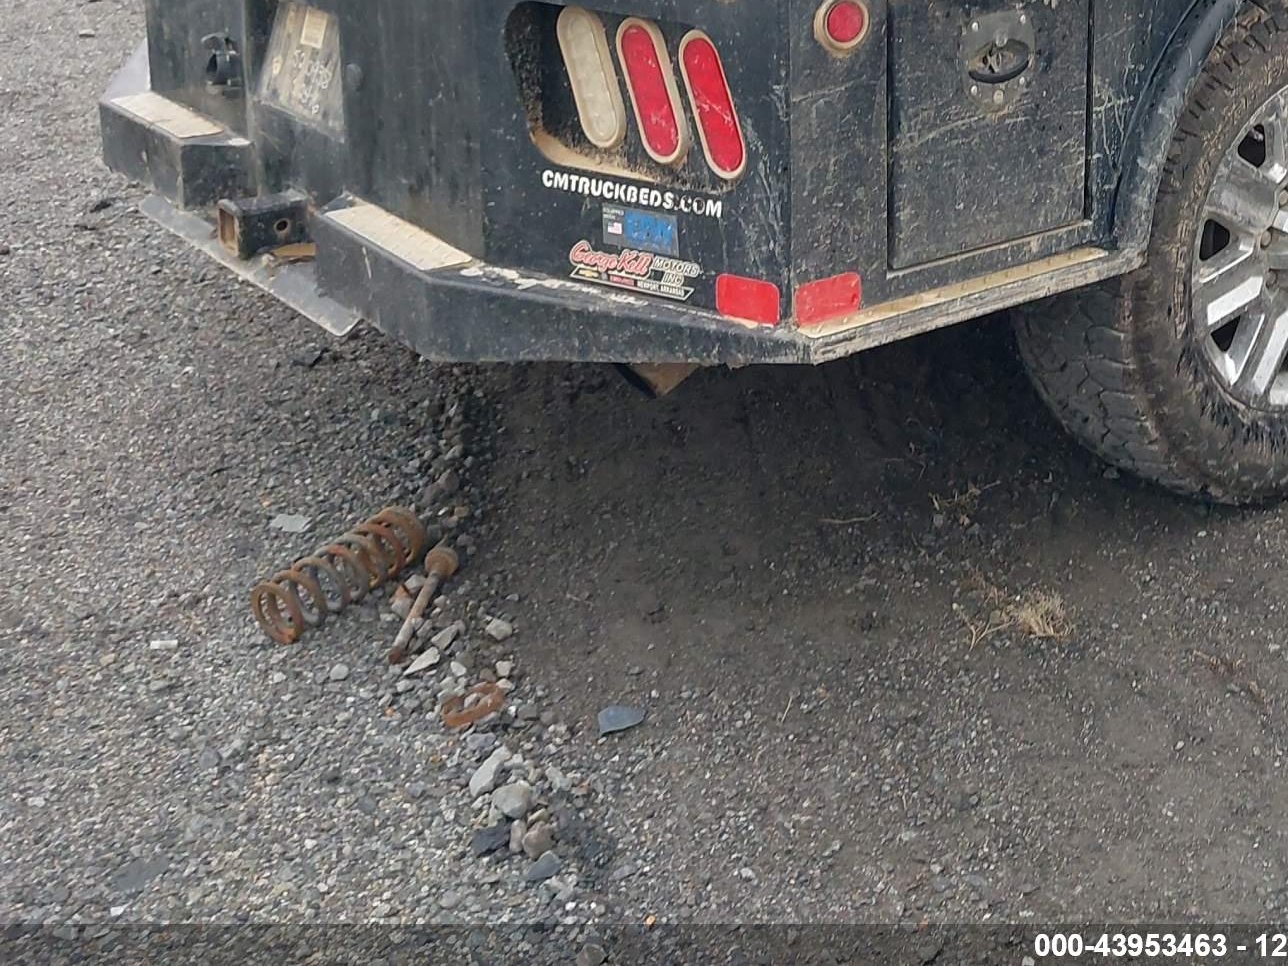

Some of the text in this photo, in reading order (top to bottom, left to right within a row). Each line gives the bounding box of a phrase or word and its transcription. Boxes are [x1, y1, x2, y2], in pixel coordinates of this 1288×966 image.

[541, 169, 723, 219] CMTRUCKBEDS.COM
[571, 241, 618, 271] George
[654, 256, 699, 277] MOTORS
[663, 273, 684, 286] INC
